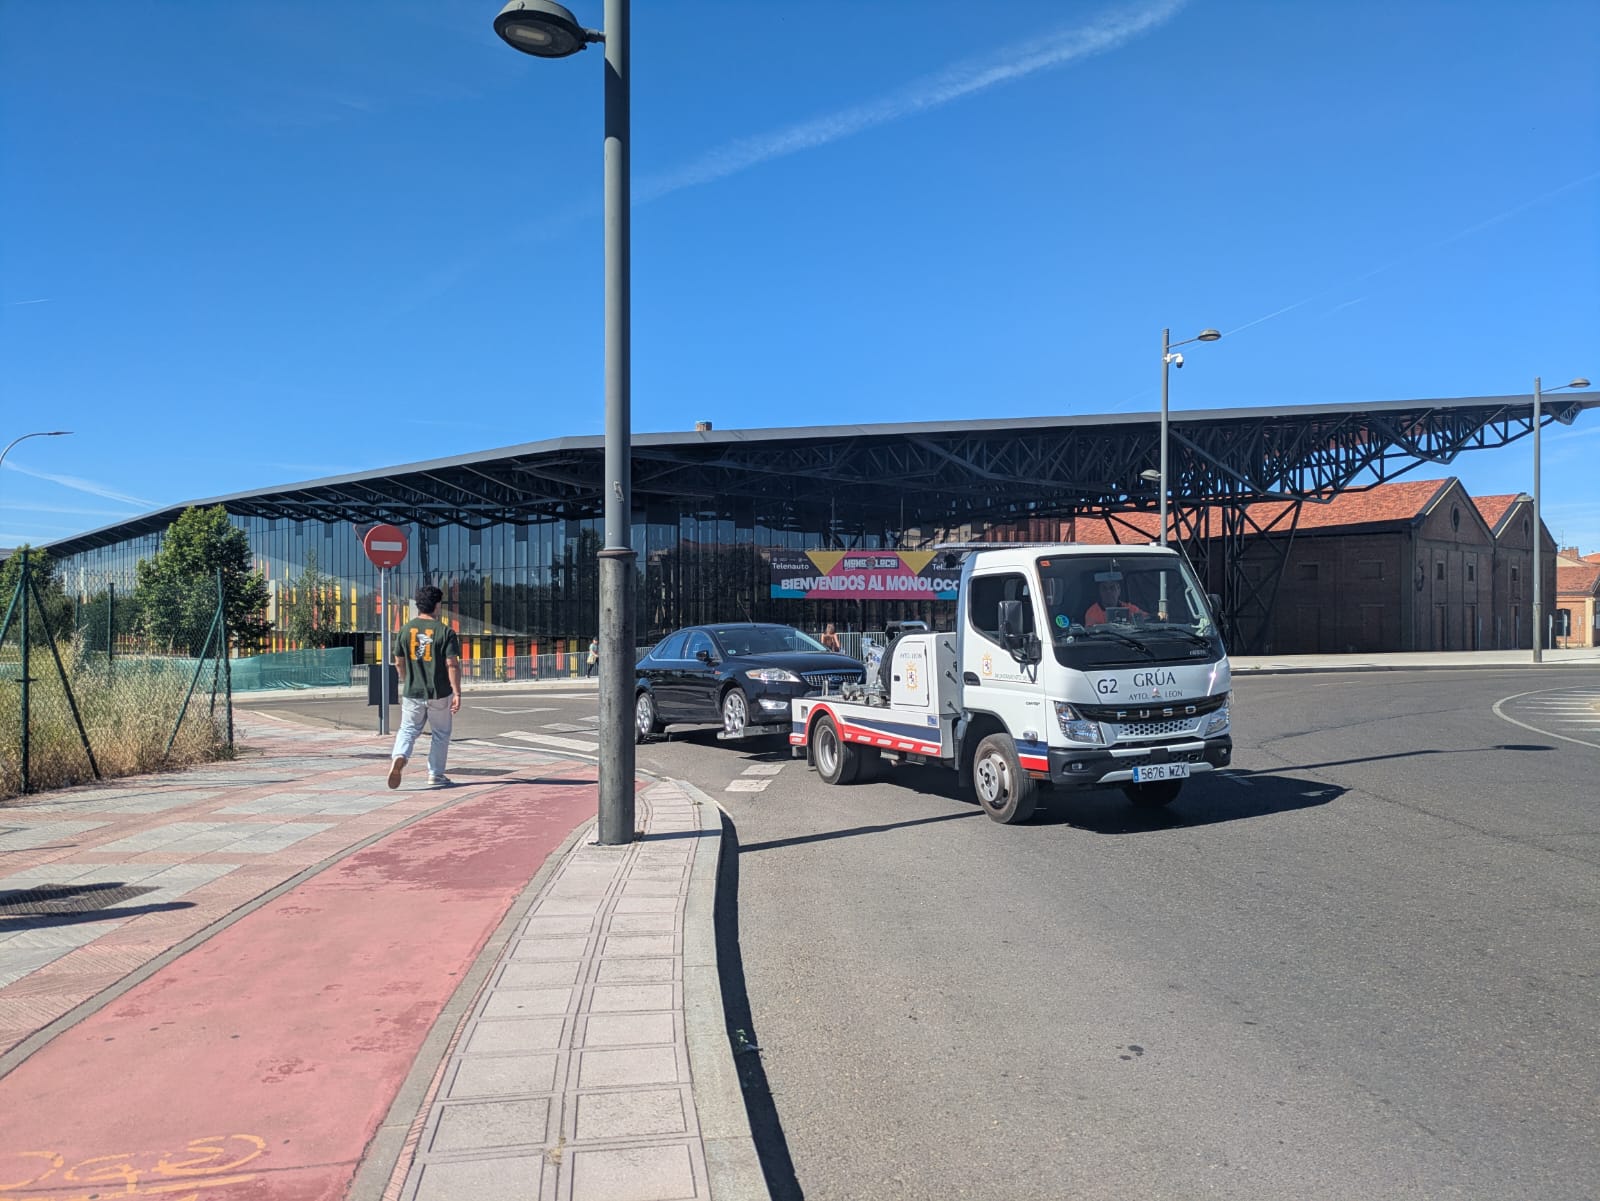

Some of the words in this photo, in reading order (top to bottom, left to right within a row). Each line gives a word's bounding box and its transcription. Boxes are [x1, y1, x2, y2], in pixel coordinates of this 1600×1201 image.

[772, 562, 810, 571] Telenauto
[781, 575, 866, 591] BIENVENIDOS
[867, 575, 885, 591] AL
[1133, 669, 1176, 687] GRÚA
[1097, 678, 1119, 694] G2
[1165, 690, 1183, 698] LEON
[1117, 705, 1197, 720] FUSO
